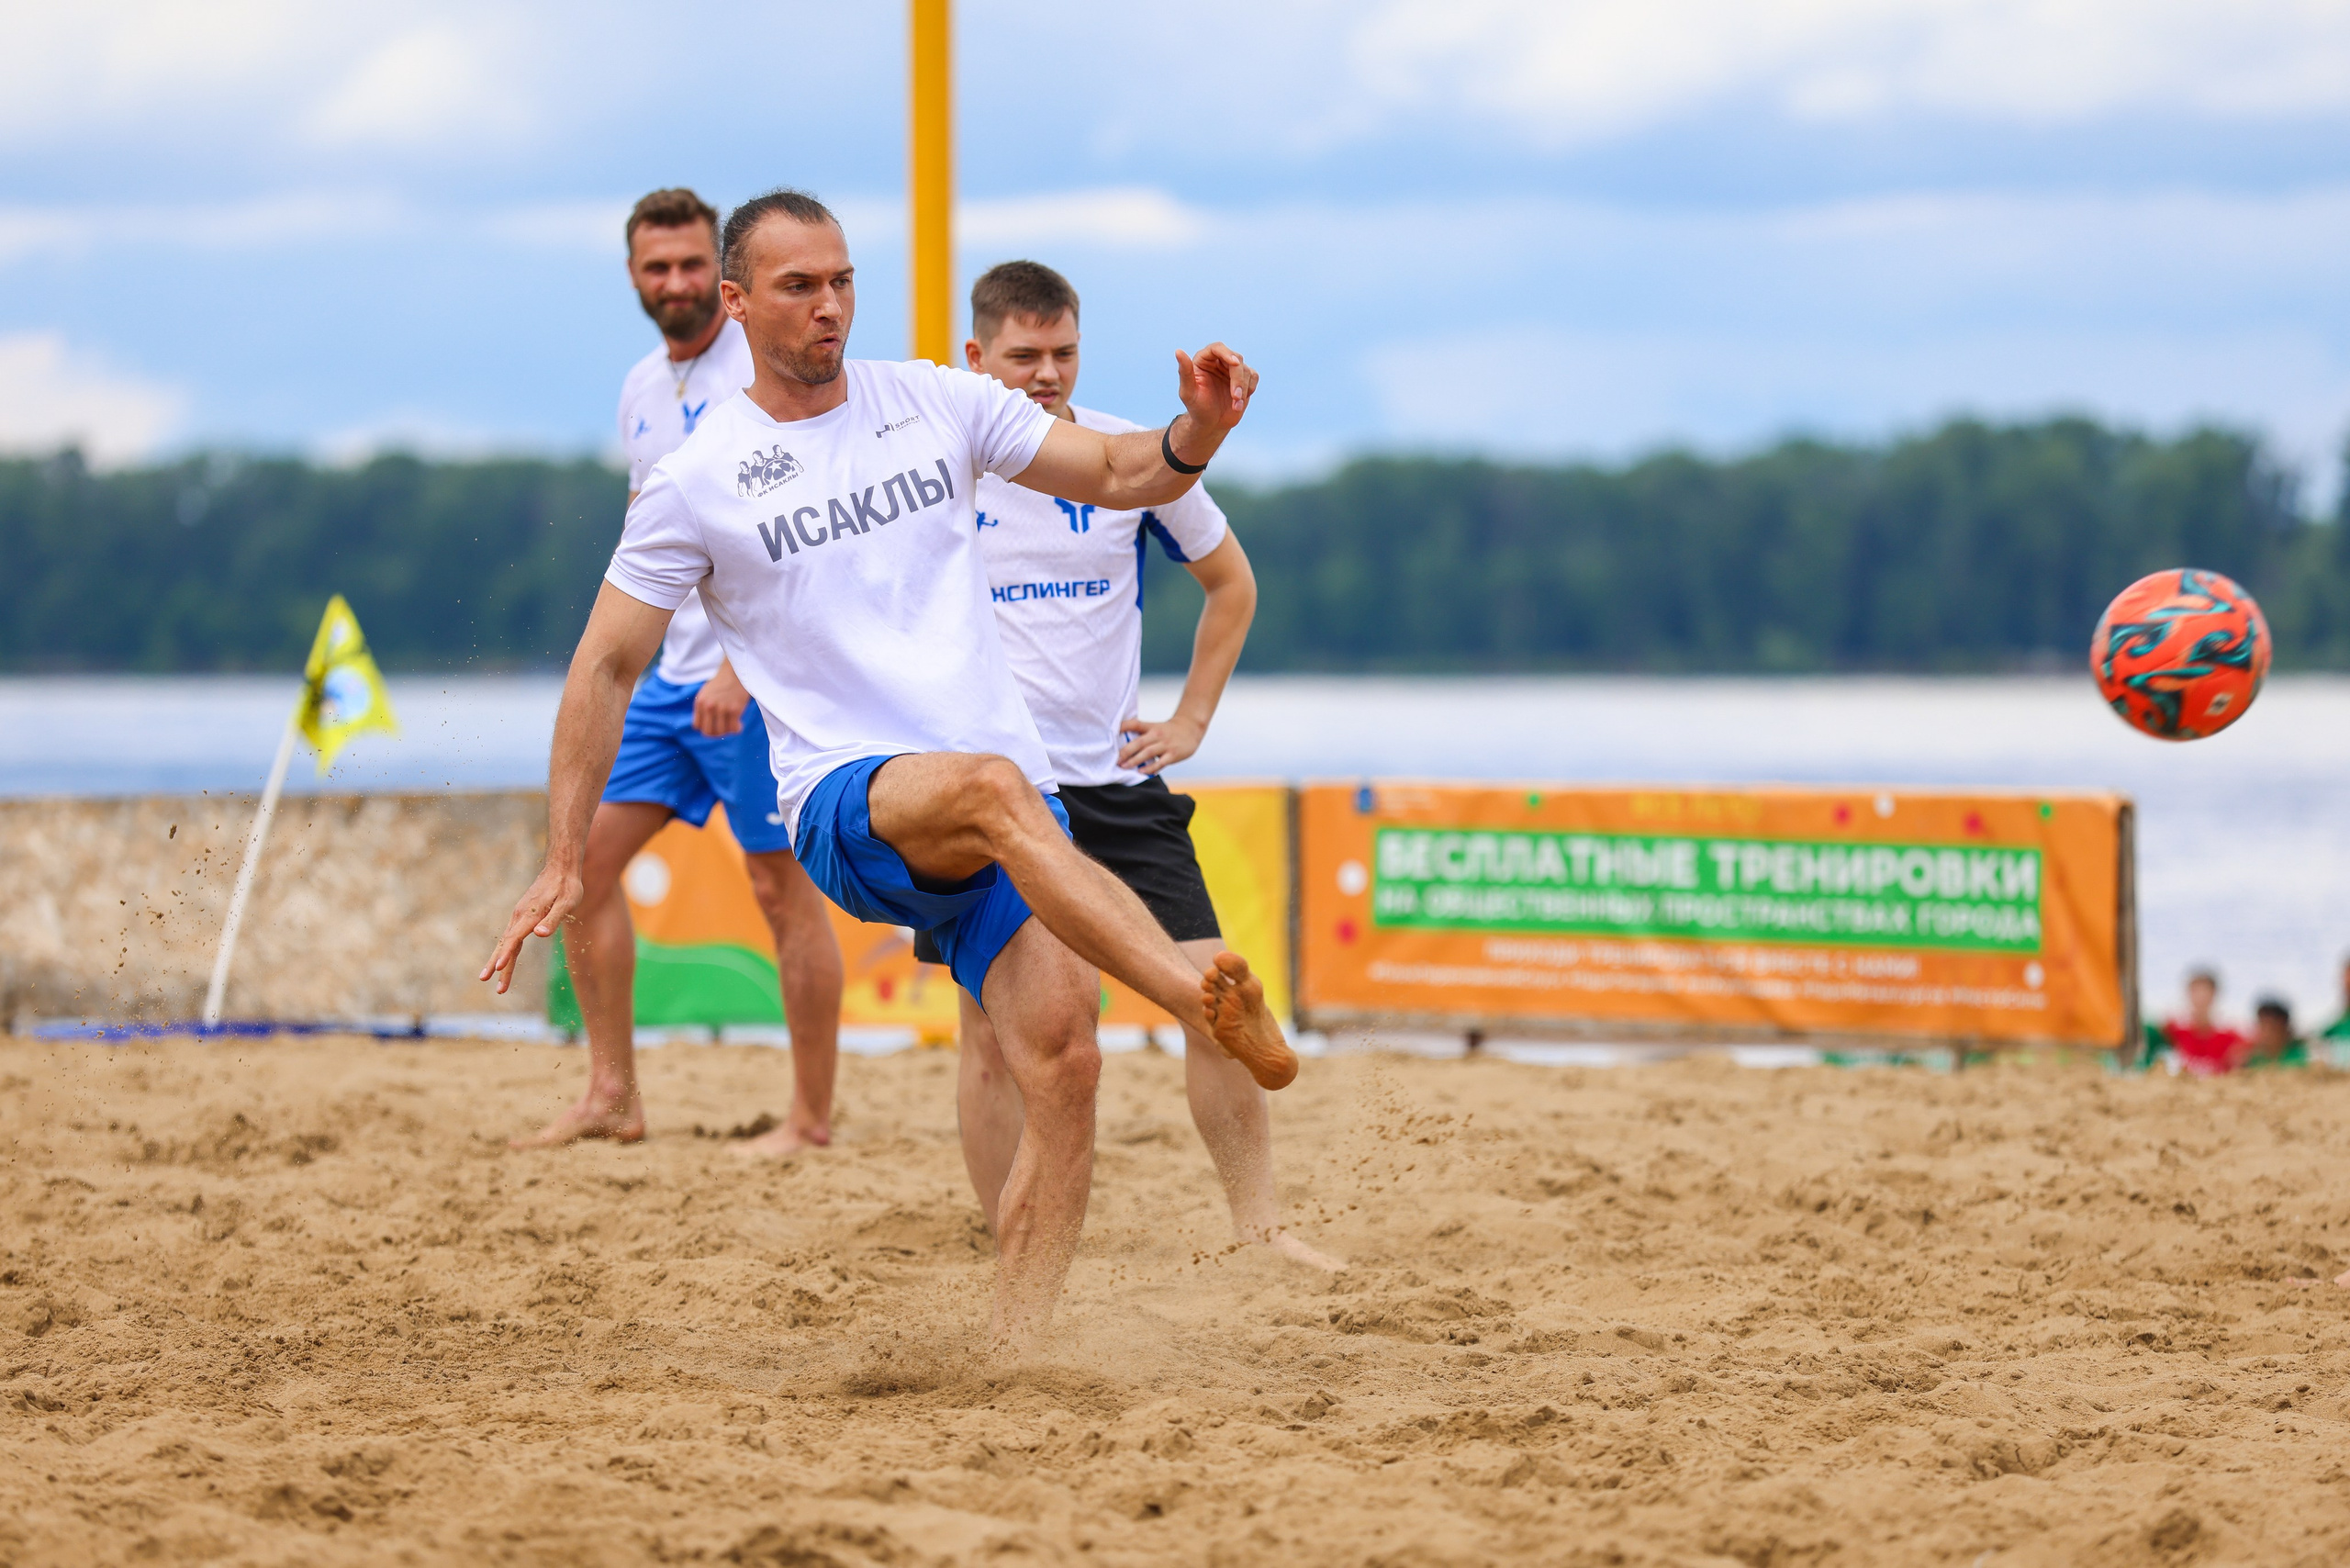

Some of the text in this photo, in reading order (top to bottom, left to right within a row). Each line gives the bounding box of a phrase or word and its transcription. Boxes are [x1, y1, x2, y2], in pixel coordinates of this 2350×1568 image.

[895, 415, 919, 428] SPORT
[757, 472, 799, 498] ФК ИСАКЛЫ
[756, 458, 955, 563] ИСАКЛЫ
[1381, 834, 2037, 901] БЕСПЛАТНЫЕ ТРЕНИРОВКИ
